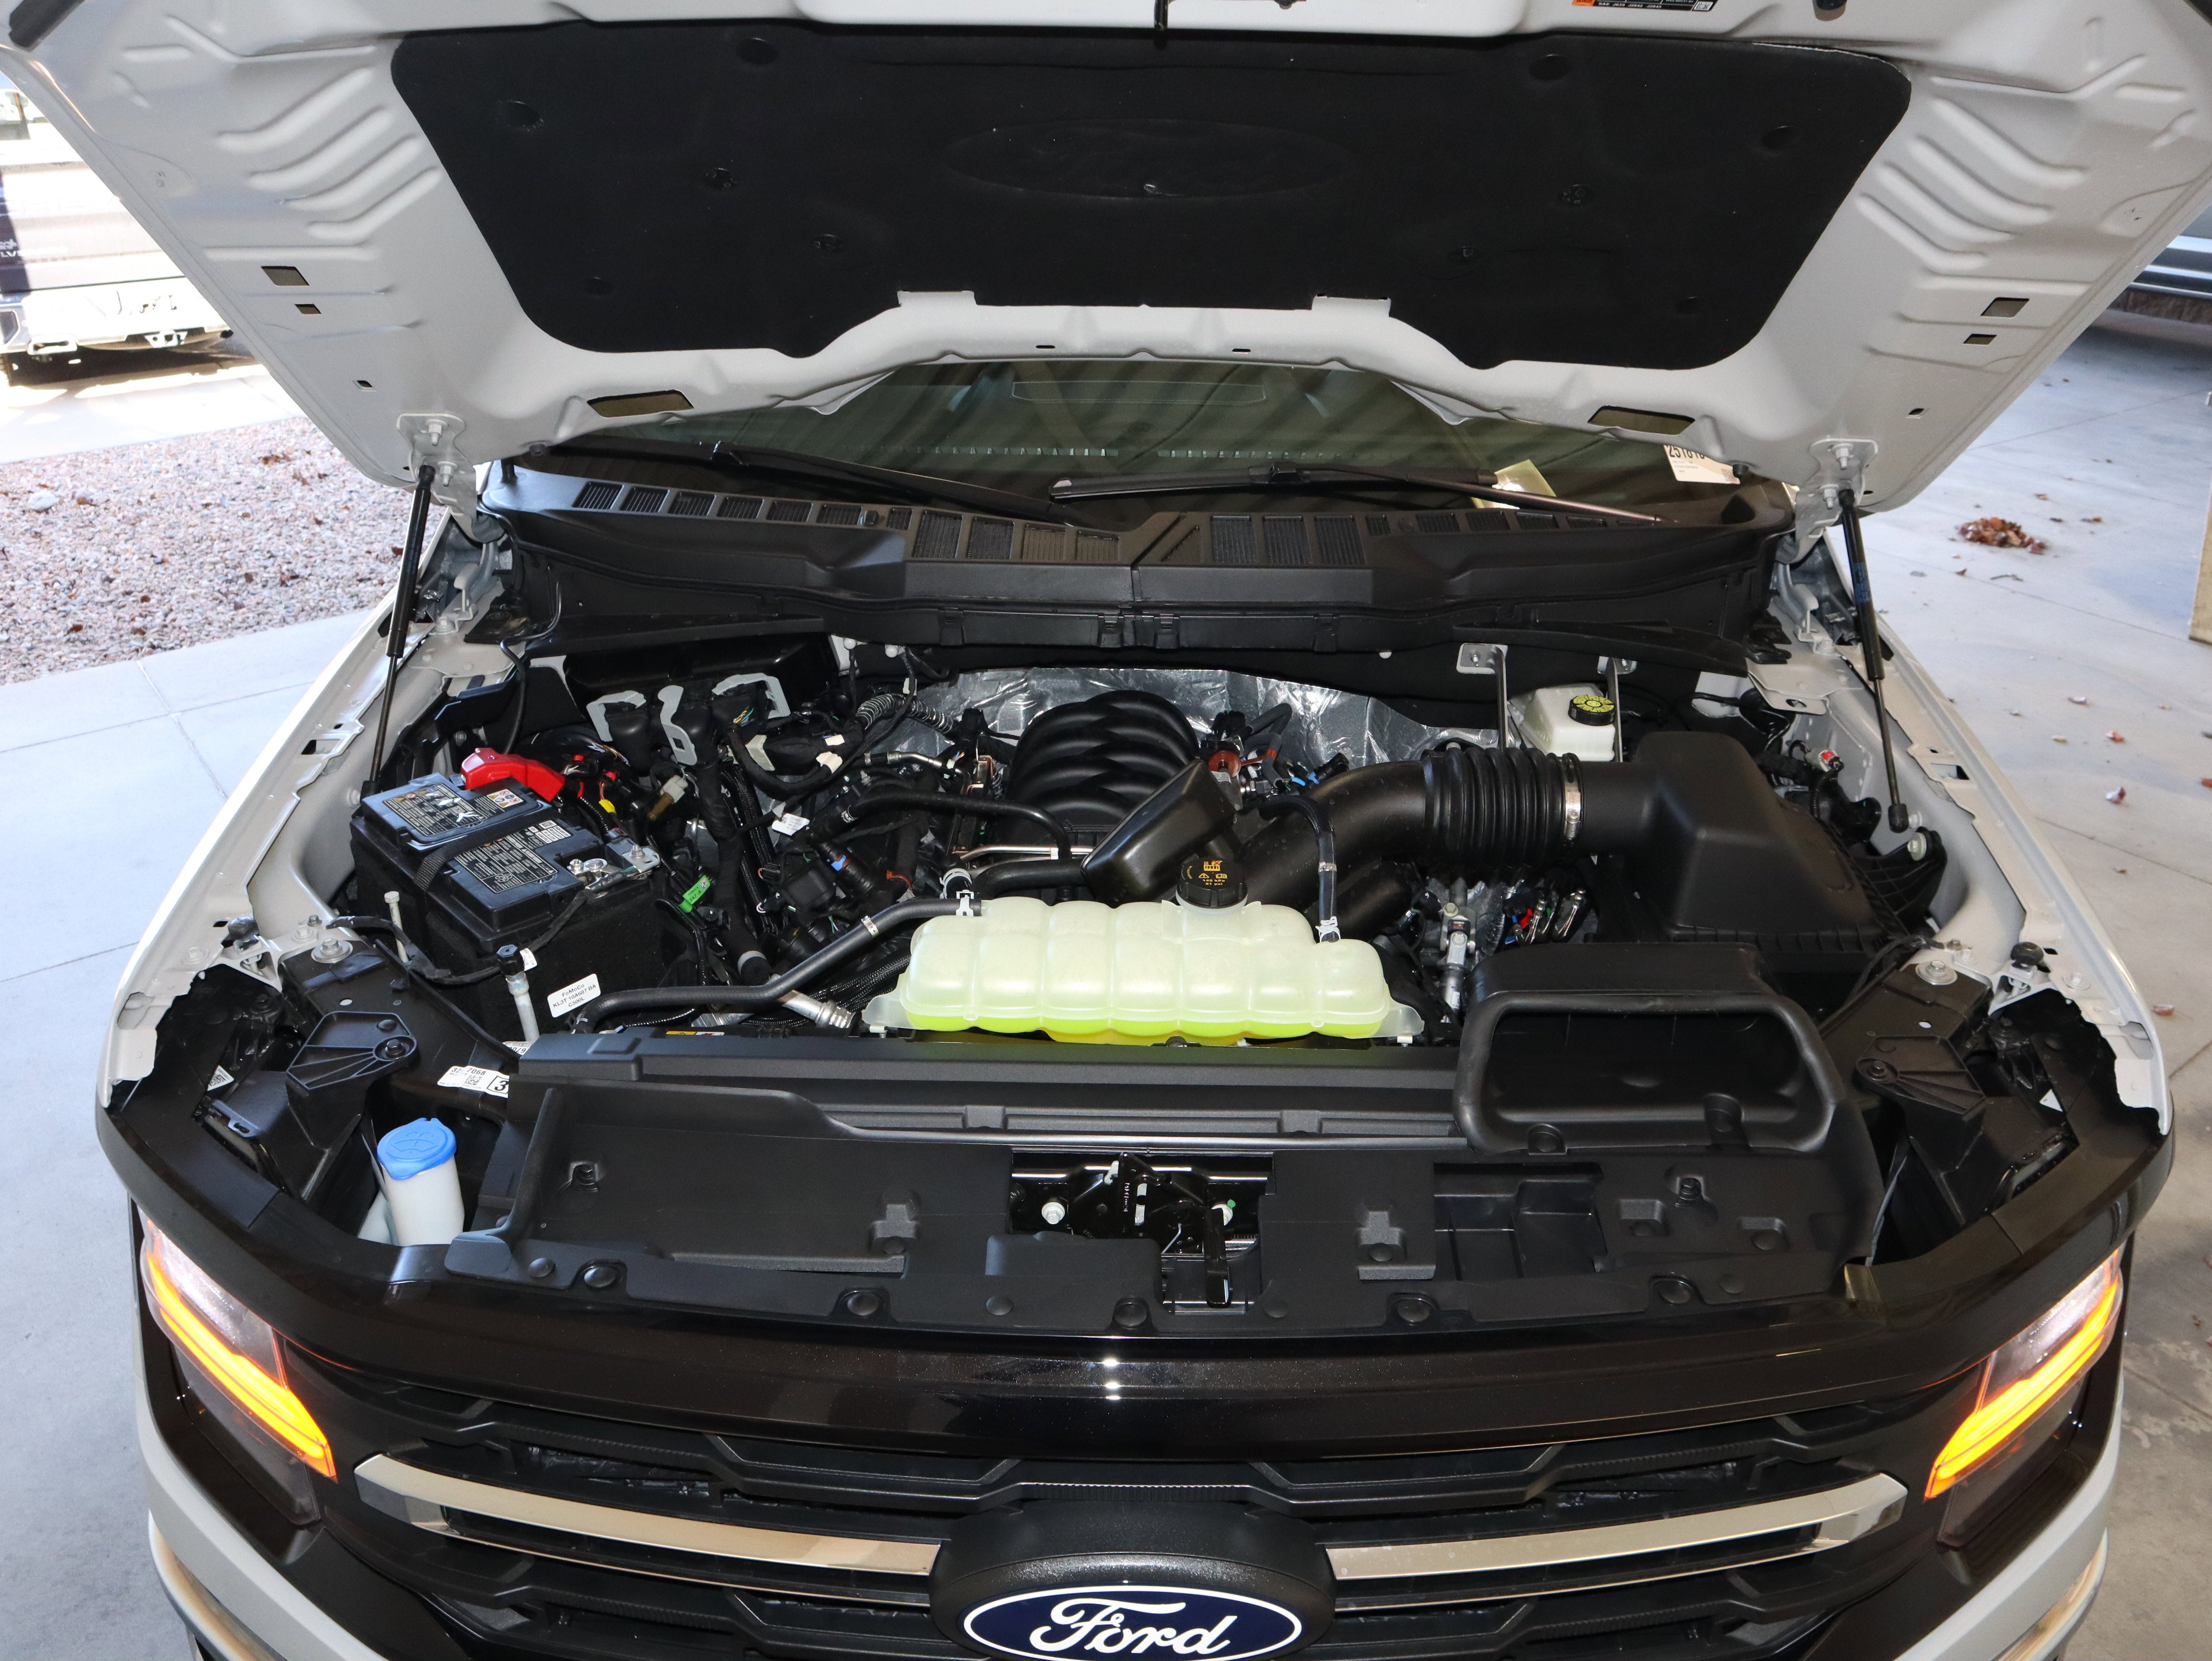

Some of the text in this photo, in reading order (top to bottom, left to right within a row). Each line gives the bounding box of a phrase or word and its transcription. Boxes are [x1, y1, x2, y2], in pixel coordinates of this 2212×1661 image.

[553, 998, 567, 1008] KL3T
[568, 989, 587, 1000] 10A687
[562, 984, 585, 997] FoMoCo
[568, 997, 585, 1007] C500L
[1029, 1598, 1238, 1655] Ford
